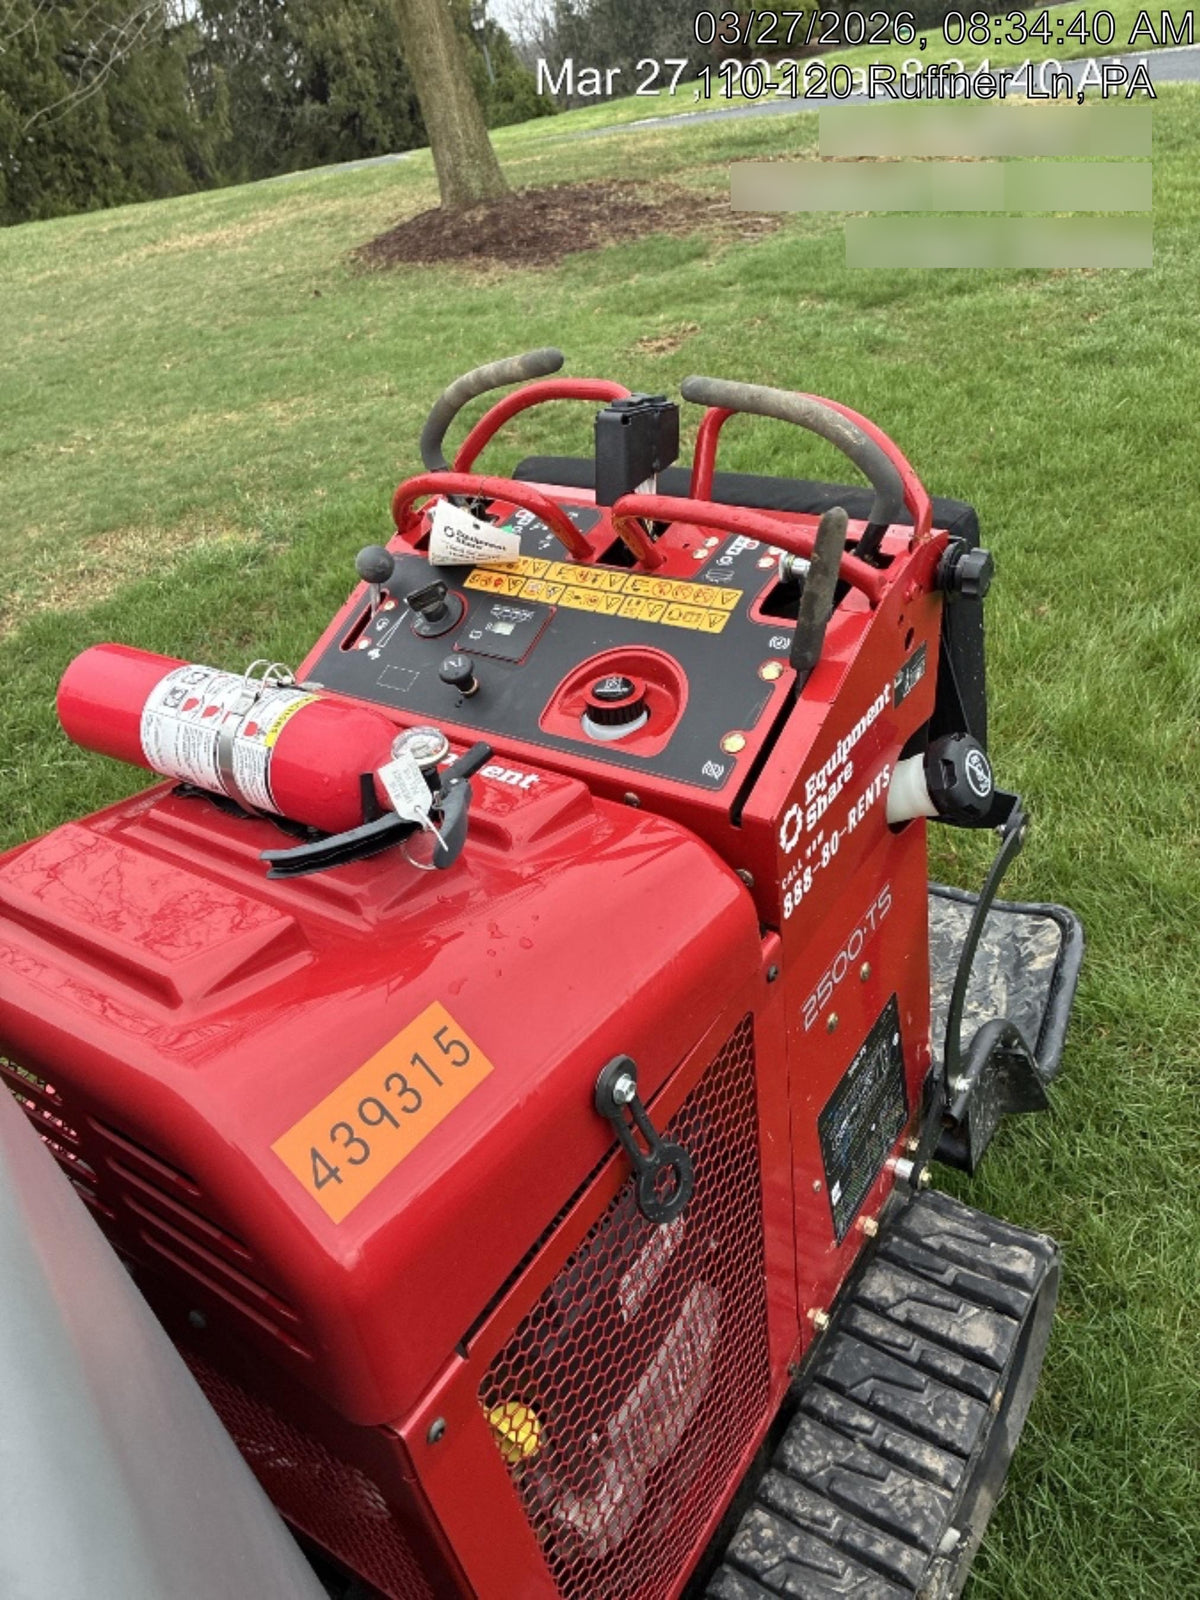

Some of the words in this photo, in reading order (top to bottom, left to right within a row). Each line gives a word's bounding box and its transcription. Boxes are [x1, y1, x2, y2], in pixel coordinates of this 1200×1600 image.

[804, 683, 891, 806] Equipment
[805, 760, 854, 833] Share
[783, 763, 891, 920] 888-80-RENTS
[309, 1024, 471, 1192] 439315
